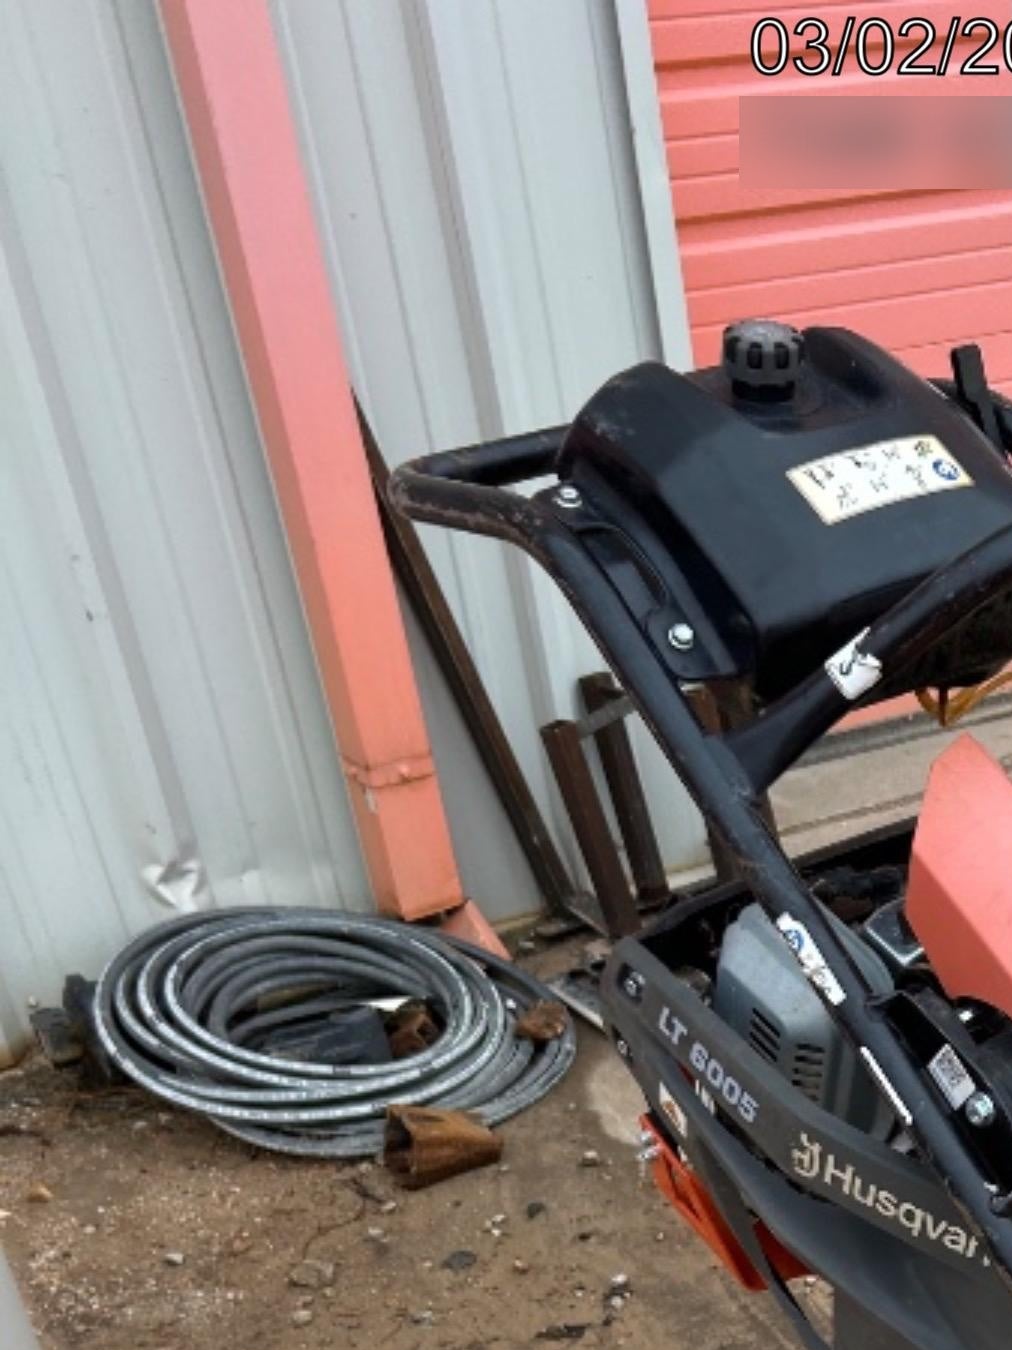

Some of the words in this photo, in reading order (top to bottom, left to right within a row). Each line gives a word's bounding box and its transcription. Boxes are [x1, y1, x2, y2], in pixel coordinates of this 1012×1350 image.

[658, 1006, 688, 1045] LT
[689, 1041, 760, 1123] 6005
[823, 1154, 991, 1267] Husqvar
